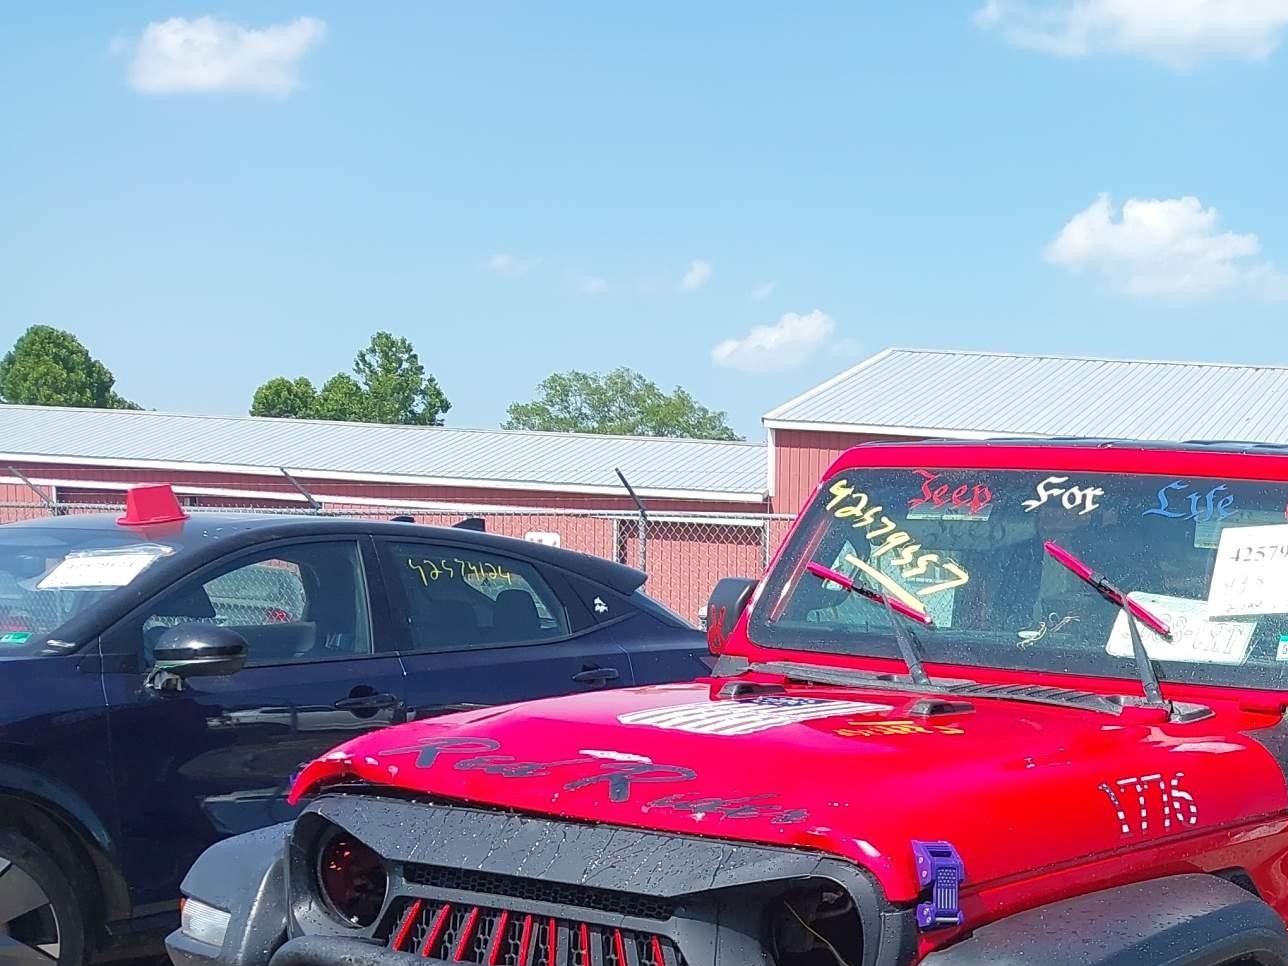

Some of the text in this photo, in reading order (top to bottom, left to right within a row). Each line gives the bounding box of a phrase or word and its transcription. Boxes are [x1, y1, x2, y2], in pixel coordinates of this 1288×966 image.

[1021, 476, 1104, 516] For
[1142, 480, 1239, 522] Life
[1098, 772, 1197, 834] 1776
